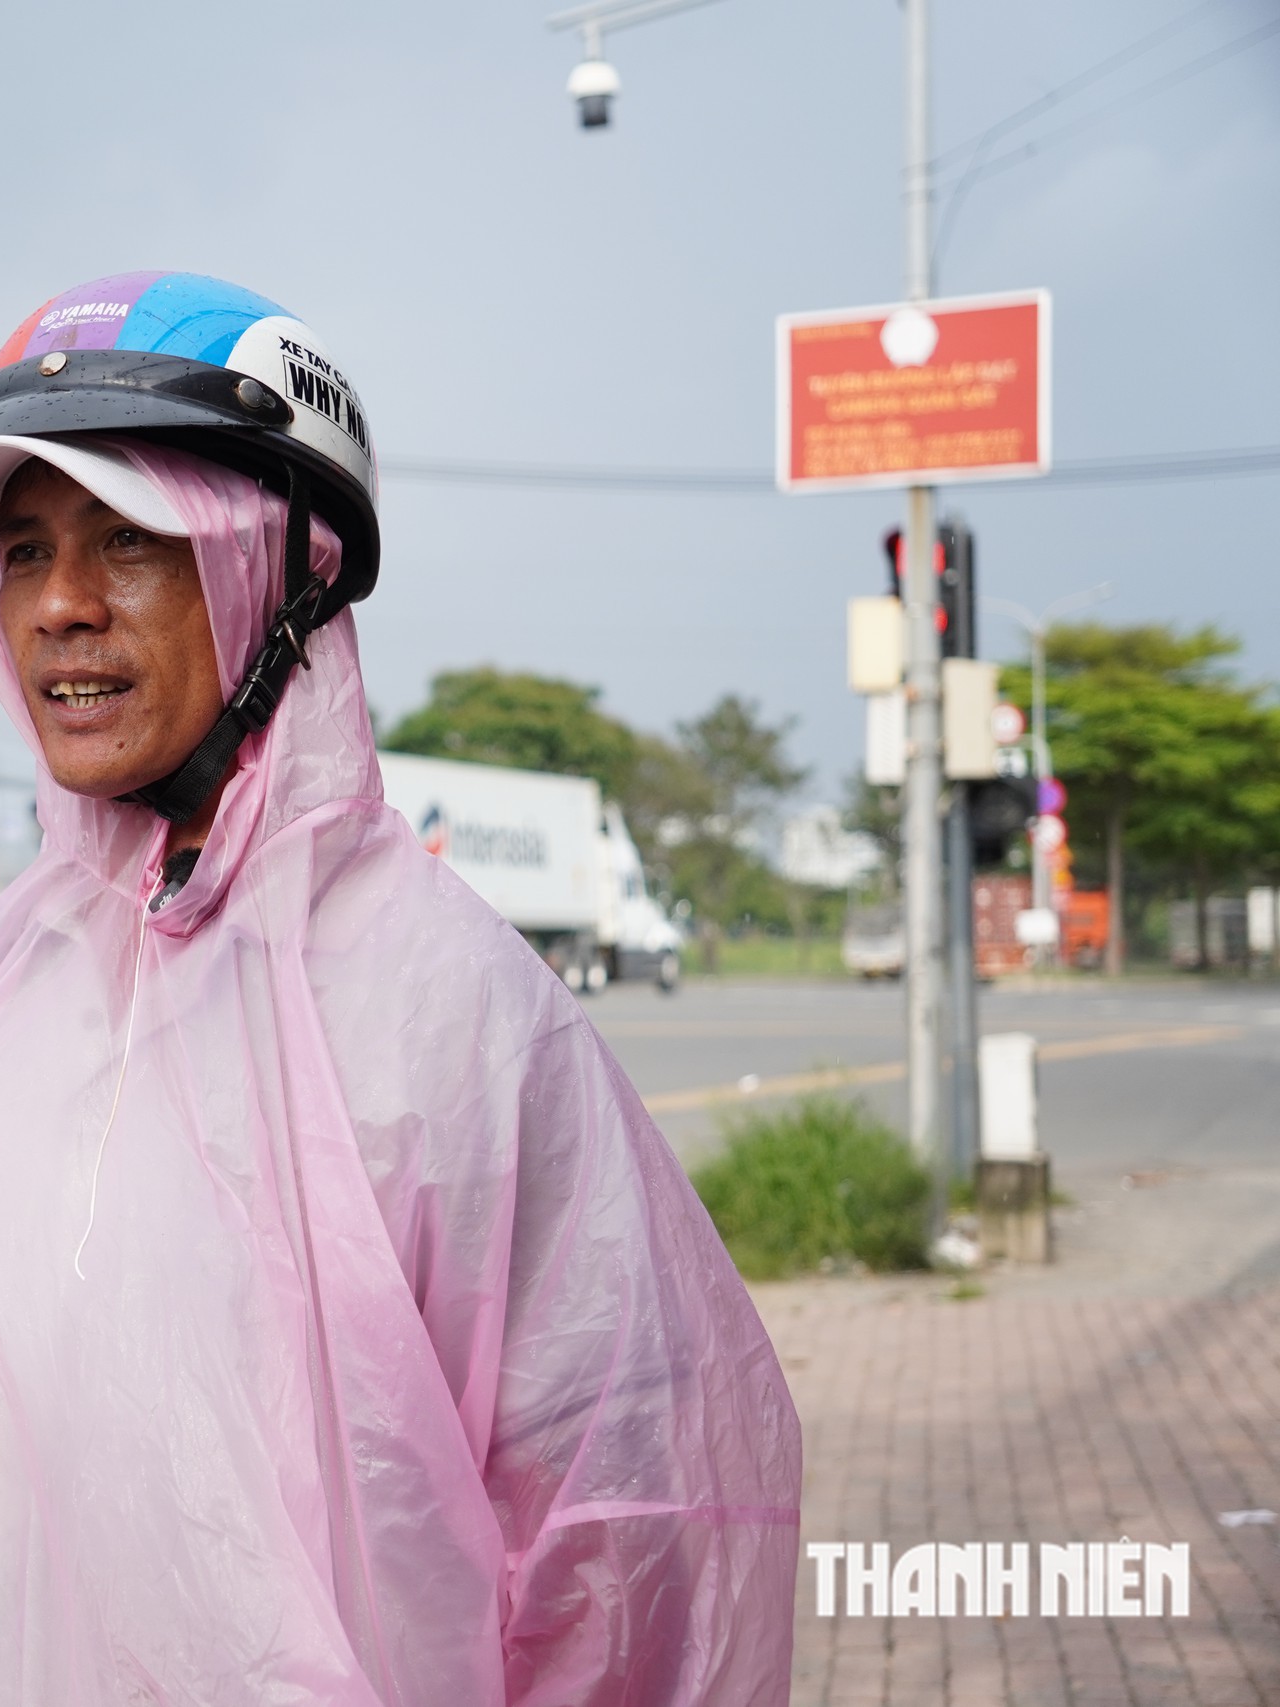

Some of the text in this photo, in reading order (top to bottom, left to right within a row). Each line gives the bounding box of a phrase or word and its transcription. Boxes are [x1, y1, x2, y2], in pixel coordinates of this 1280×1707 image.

[60, 303, 129, 319] YAMAHA
[278, 336, 303, 359] XE
[304, 348, 331, 376] TAY
[288, 361, 341, 424] WHY
